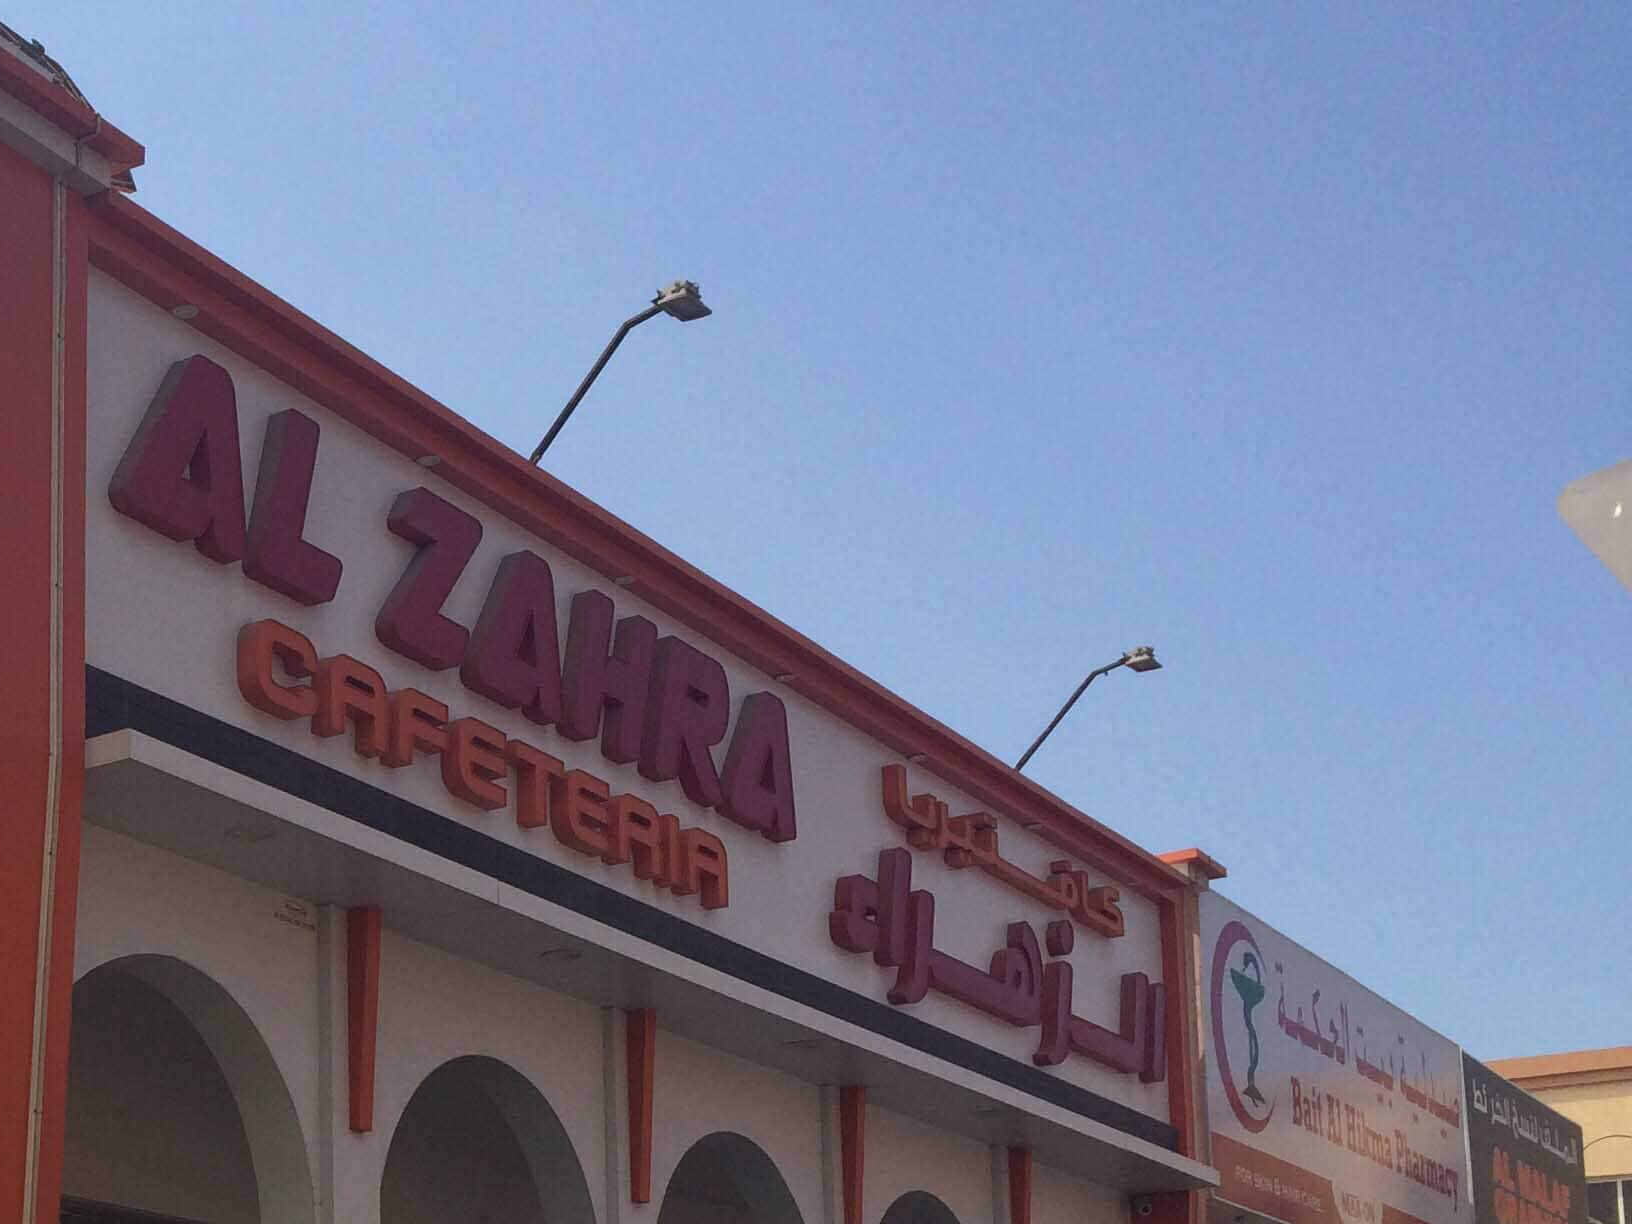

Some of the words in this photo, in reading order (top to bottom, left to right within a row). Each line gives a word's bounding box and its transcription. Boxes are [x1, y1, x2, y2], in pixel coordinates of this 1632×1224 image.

[108, 354, 343, 606] AL
[374, 486, 797, 843] ZAHRA
[236, 618, 729, 910] CAFETERIA
[881, 763, 1124, 937] كافتيريا
[829, 847, 1166, 1083] الزهراء
[1275, 961, 1350, 1065] الحكمة
[1291, 1075, 1324, 1137] Bait
[1394, 1129, 1458, 1212] Pharmacy
